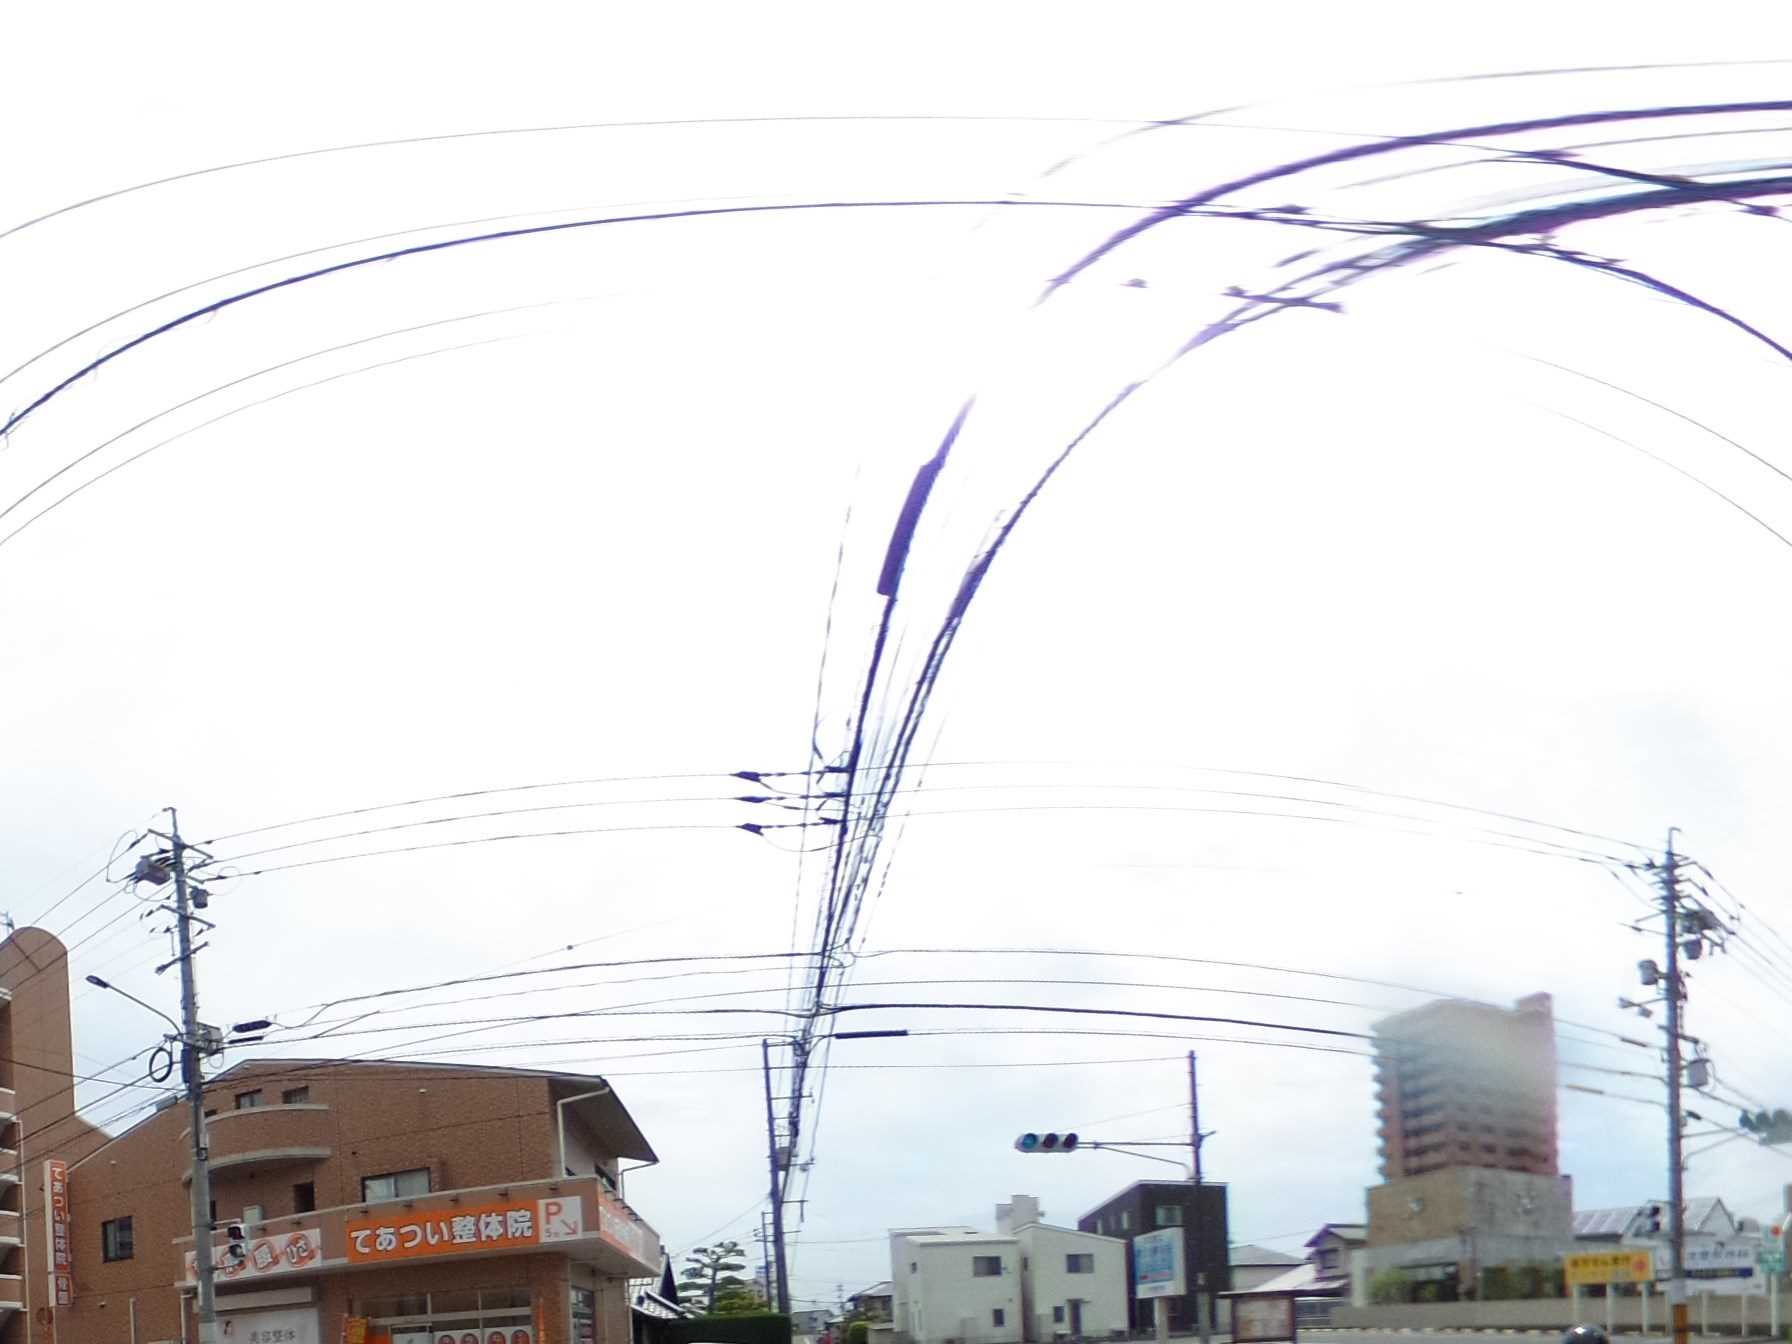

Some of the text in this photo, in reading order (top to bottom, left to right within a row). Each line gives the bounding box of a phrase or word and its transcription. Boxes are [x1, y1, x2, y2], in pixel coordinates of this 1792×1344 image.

[545, 1201, 562, 1225] P
[350, 1208, 533, 1254] てあつい整体院
